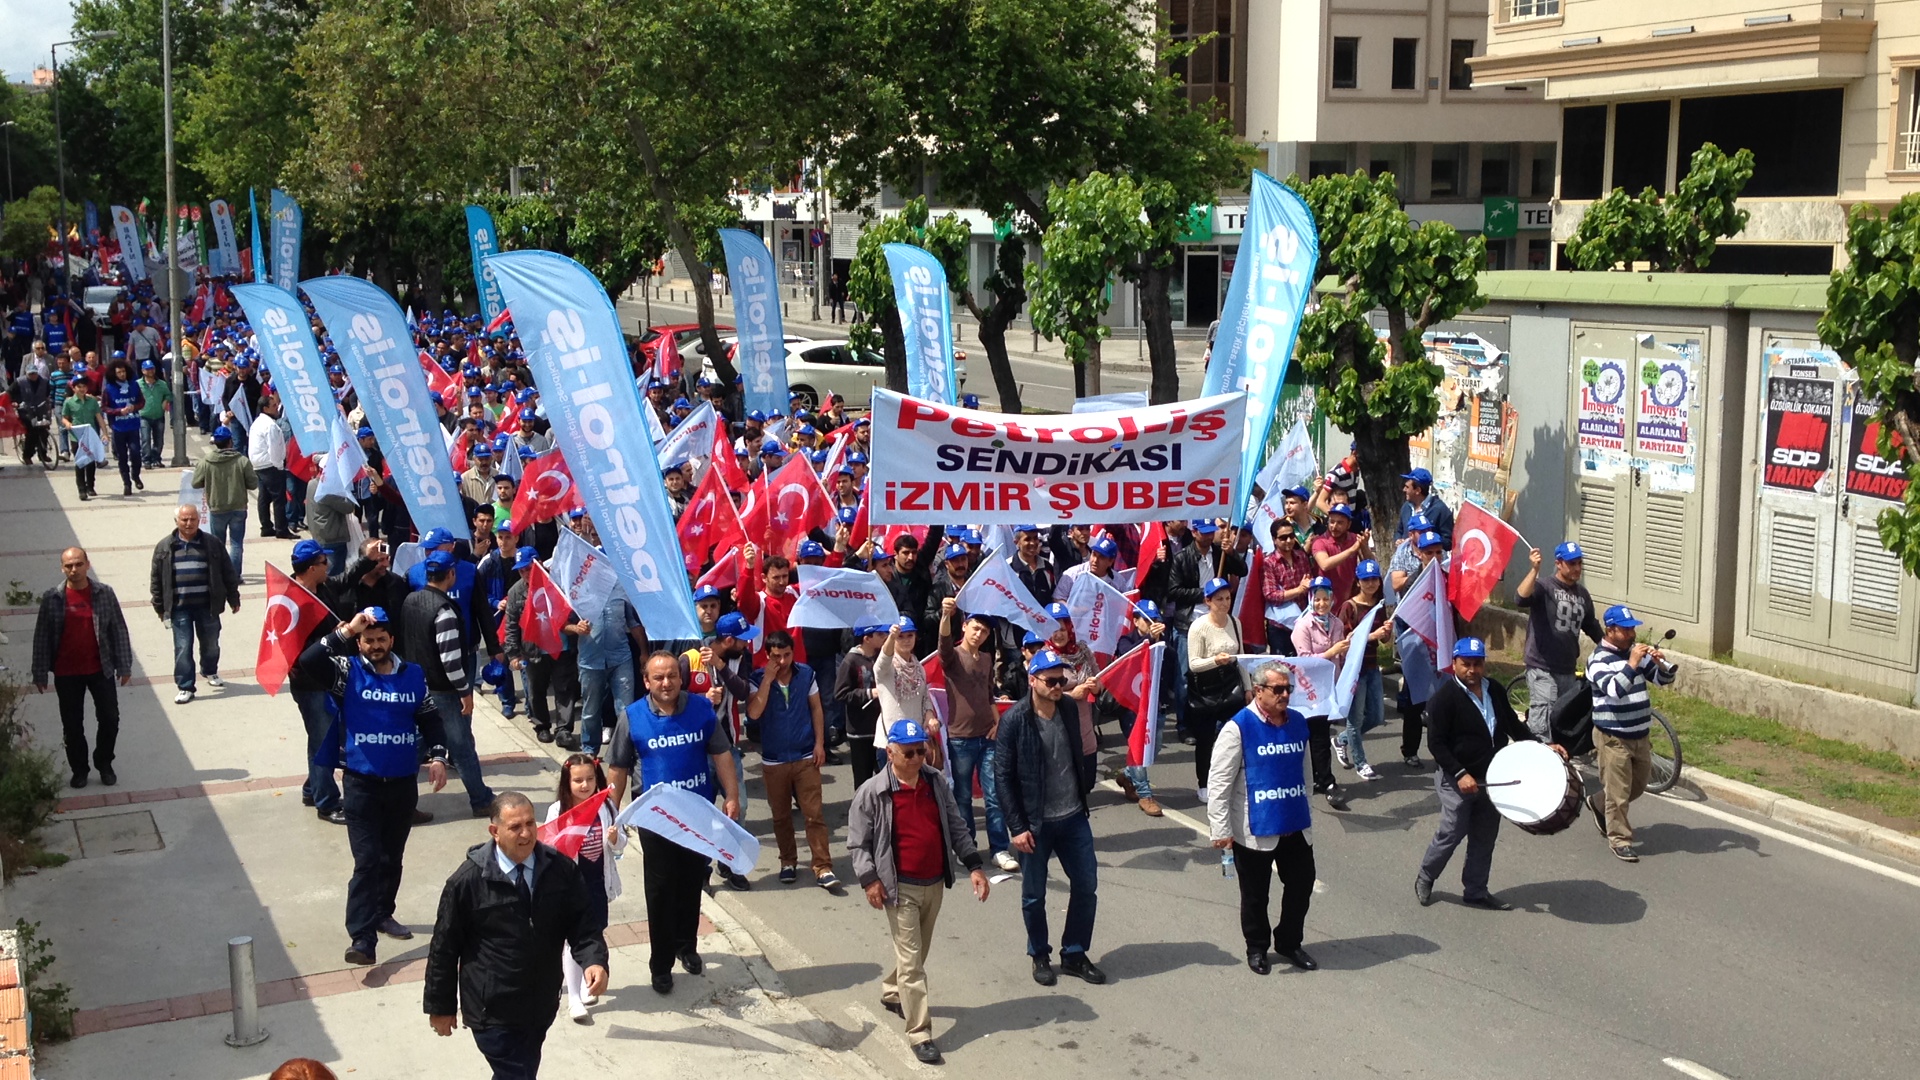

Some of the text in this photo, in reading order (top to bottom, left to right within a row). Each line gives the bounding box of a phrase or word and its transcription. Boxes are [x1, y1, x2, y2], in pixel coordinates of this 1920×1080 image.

[1223, 214, 1246, 229] TE
[1524, 210, 1552, 224] TE
[897, 398, 1226, 443] Petrol-iş
[1771, 448, 1820, 467] SDP
[982, 577, 1048, 625] petrol-iş
[1554, 600, 1585, 637] 93
